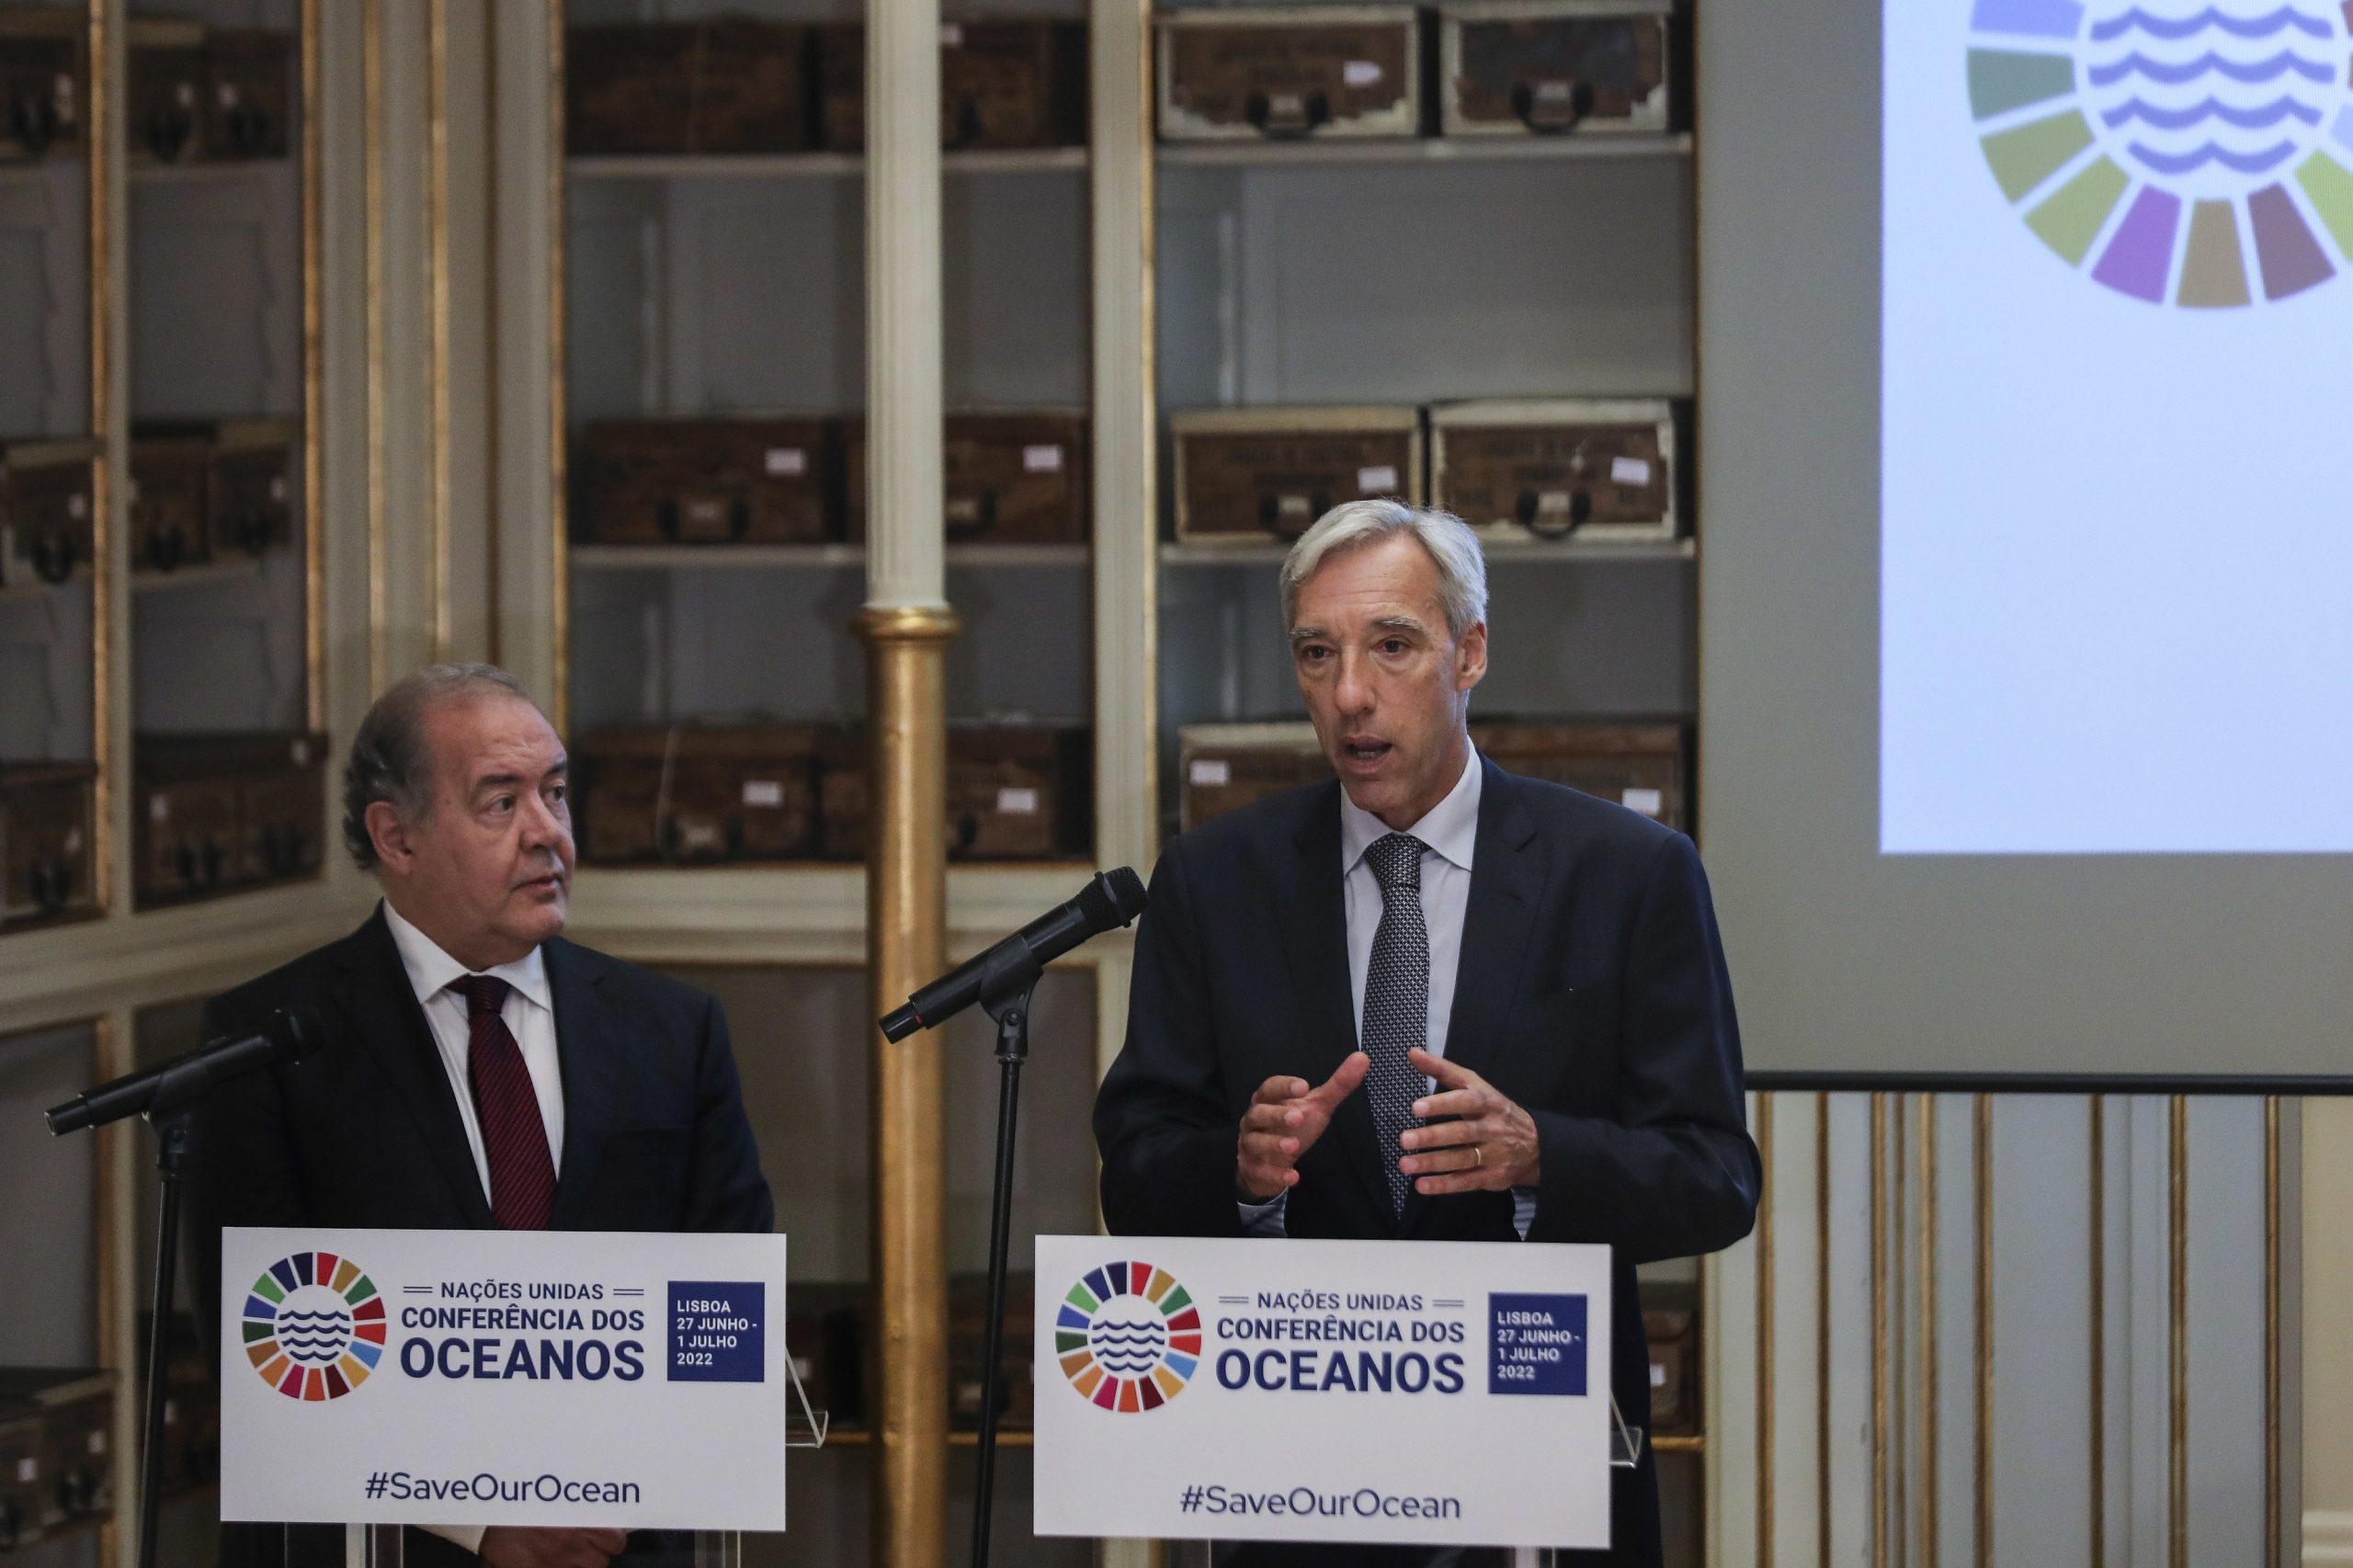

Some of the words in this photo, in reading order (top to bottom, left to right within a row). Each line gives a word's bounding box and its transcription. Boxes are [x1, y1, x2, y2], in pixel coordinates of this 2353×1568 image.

[441, 1278, 522, 1302] NAÇÕES
[529, 1283, 604, 1300] UNIDAS
[676, 1300, 732, 1313] LISBOA
[1257, 1290, 1340, 1312] NAÇÕES
[1347, 1293, 1423, 1311] UNIDAS
[401, 1303, 584, 1330] CONFERÊNCIA
[592, 1309, 644, 1331] DOS
[676, 1317, 694, 1330] 27
[698, 1317, 749, 1331] JUNHO
[1497, 1311, 1553, 1325] LISBOA
[1216, 1314, 1403, 1342] CONFERÊNCIA
[1411, 1321, 1464, 1343] DOS
[1497, 1329, 1515, 1342] 27
[1518, 1330, 1572, 1344] JUNHO
[677, 1335, 684, 1347] 1
[688, 1335, 738, 1348] JULHO
[400, 1337, 644, 1381] OCEANOS
[676, 1353, 713, 1365] 2022
[1498, 1347, 1506, 1360] 1
[1509, 1347, 1561, 1360] JULHO
[1215, 1347, 1464, 1393] OCEANOS
[1497, 1365, 1535, 1380] 2022
[365, 1471, 640, 1504] #SaveOurOcean
[1180, 1484, 1461, 1518] #SaveOurOcean
